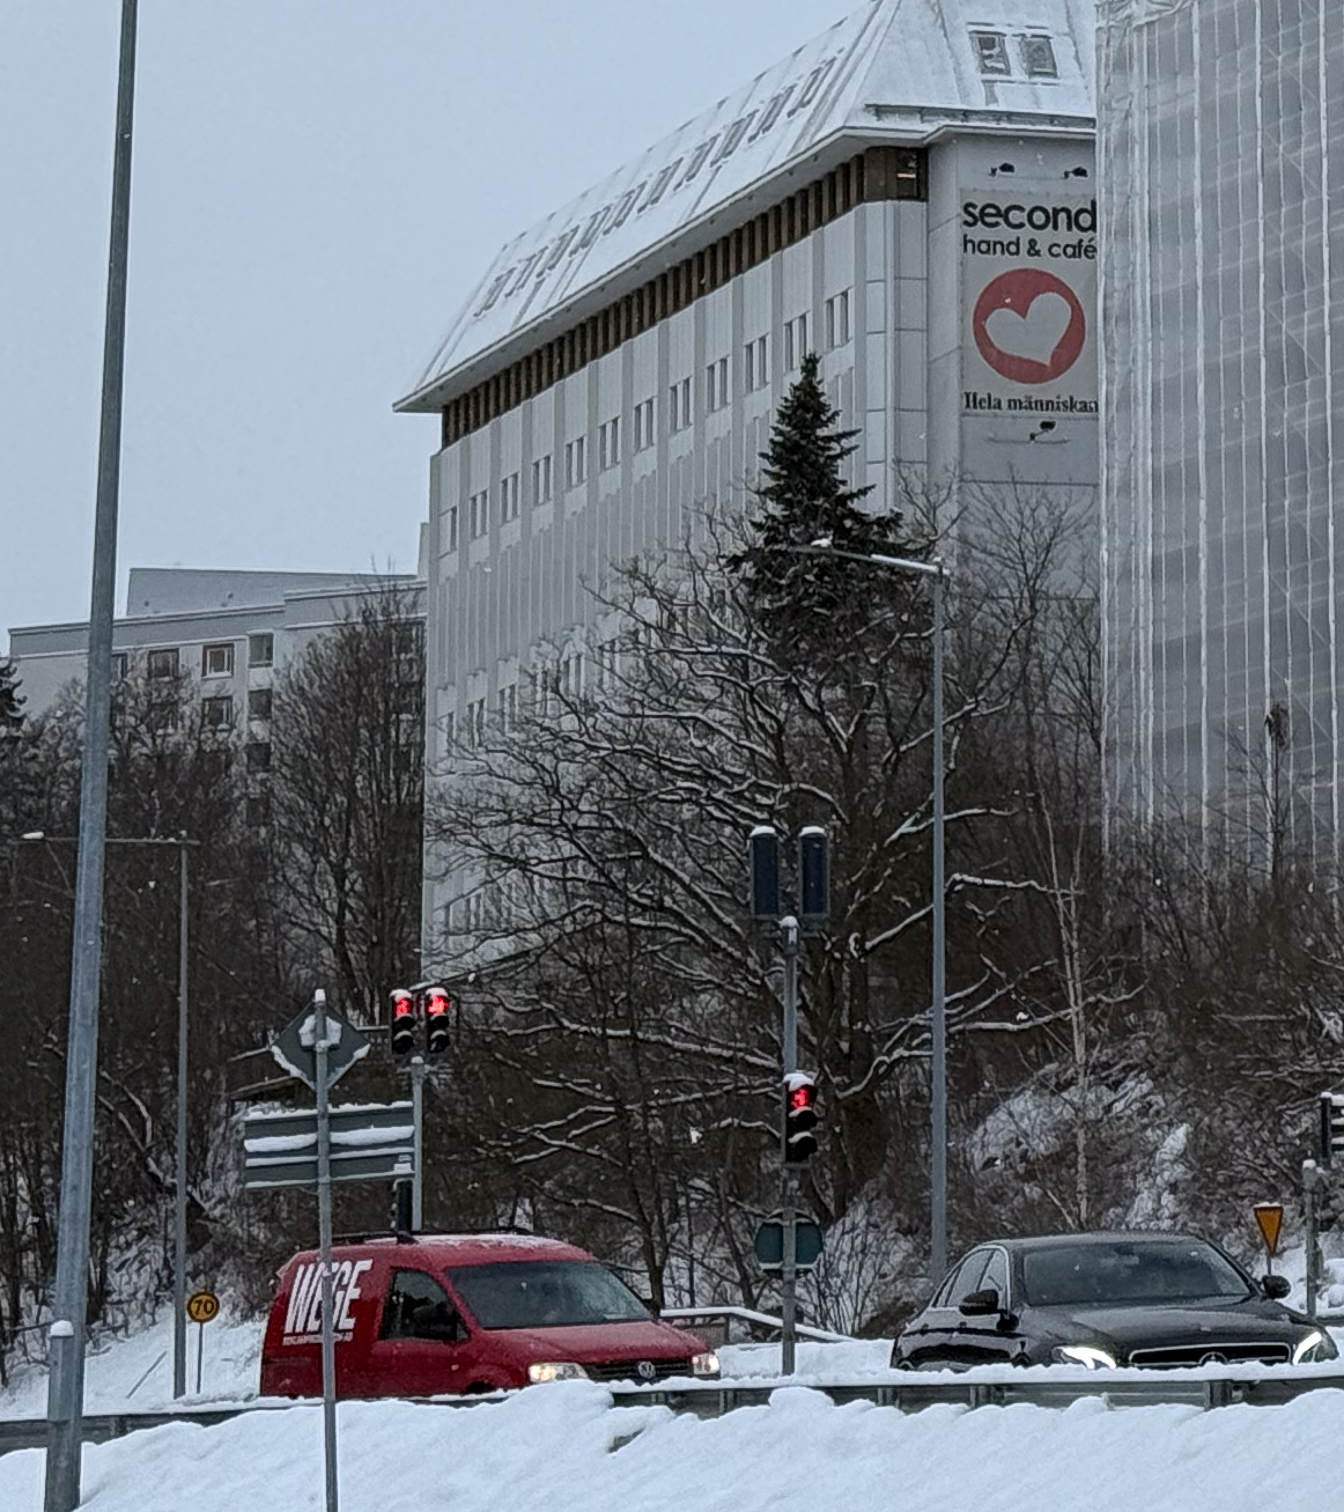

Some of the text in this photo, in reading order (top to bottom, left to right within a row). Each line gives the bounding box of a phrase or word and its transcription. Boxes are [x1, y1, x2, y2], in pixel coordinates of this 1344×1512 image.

[962, 199, 1097, 233] second
[963, 233, 1097, 260] hand & café
[964, 391, 1098, 413] Hela människan
[194, 1299, 215, 1316] 70
